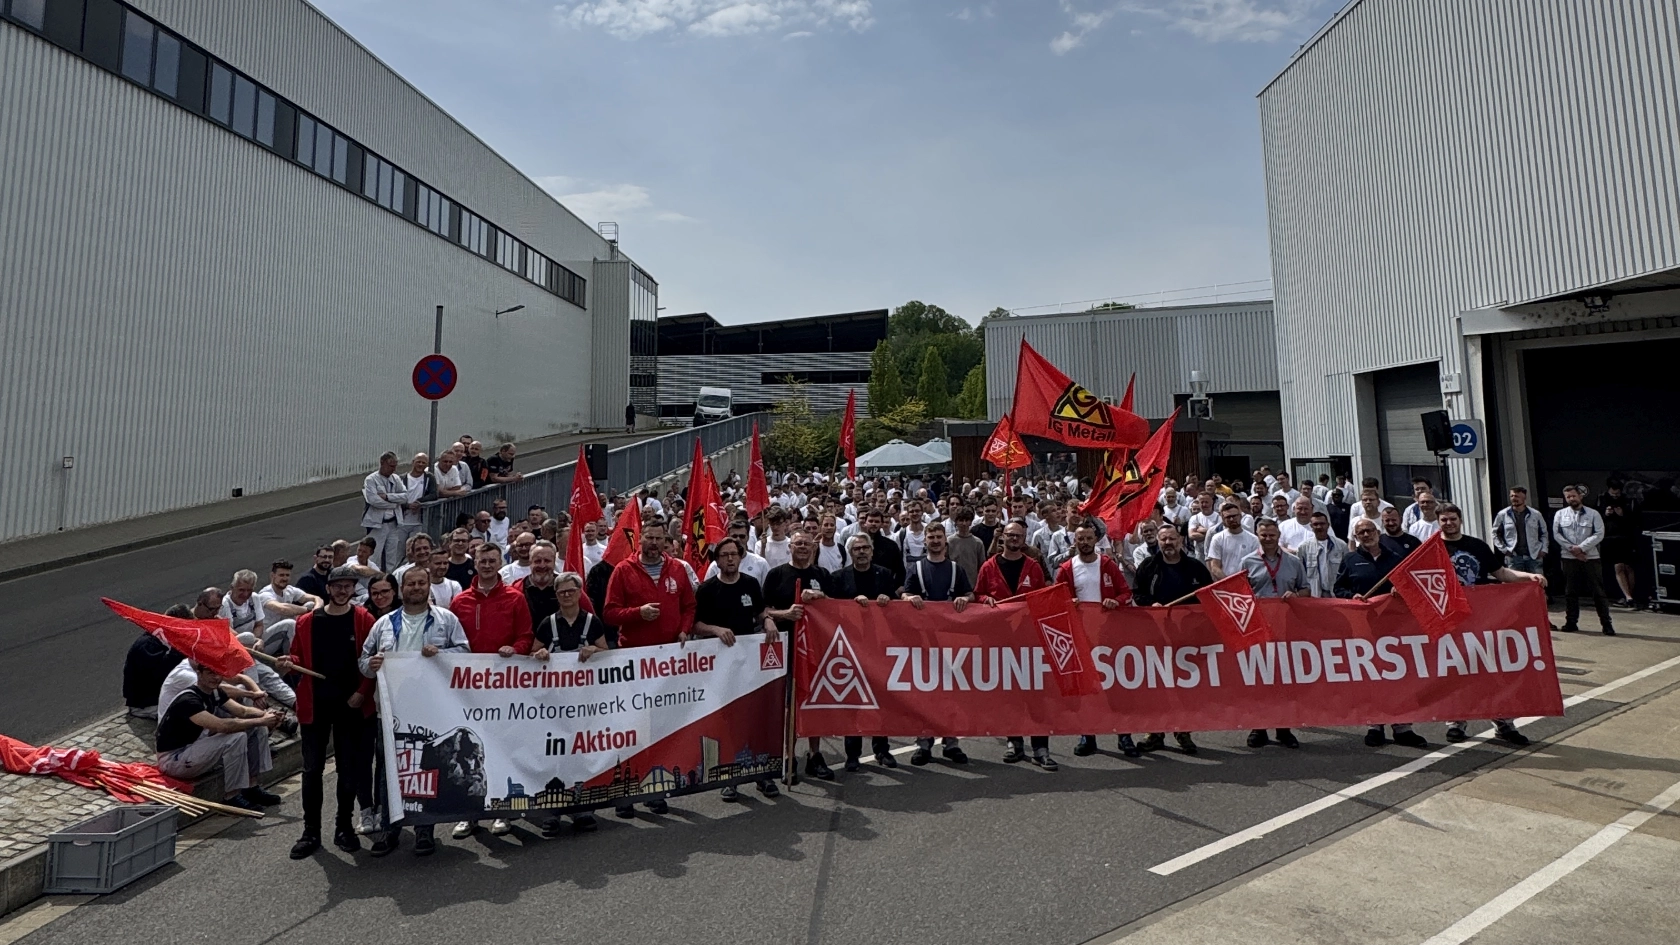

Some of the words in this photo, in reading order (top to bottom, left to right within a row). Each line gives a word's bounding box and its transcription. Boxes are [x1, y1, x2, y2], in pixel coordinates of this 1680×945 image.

[1048, 417, 1064, 435] IG
[1068, 422, 1116, 443] Metall
[1453, 431, 1474, 447] 02
[450, 664, 594, 690] Metallerinnen
[598, 659, 635, 684] und
[640, 651, 717, 680] Metaller
[809, 638, 870, 704] IGM
[886, 645, 1053, 692] ZUKUNF
[1091, 643, 1225, 691] SONST
[1235, 626, 1547, 687] WIDERSTAND!
[463, 705, 501, 722] vom
[507, 696, 627, 721] Motorenwerk
[632, 686, 706, 711] Chemnitz
[546, 731, 566, 756] in
[571, 726, 637, 755] Aktion
